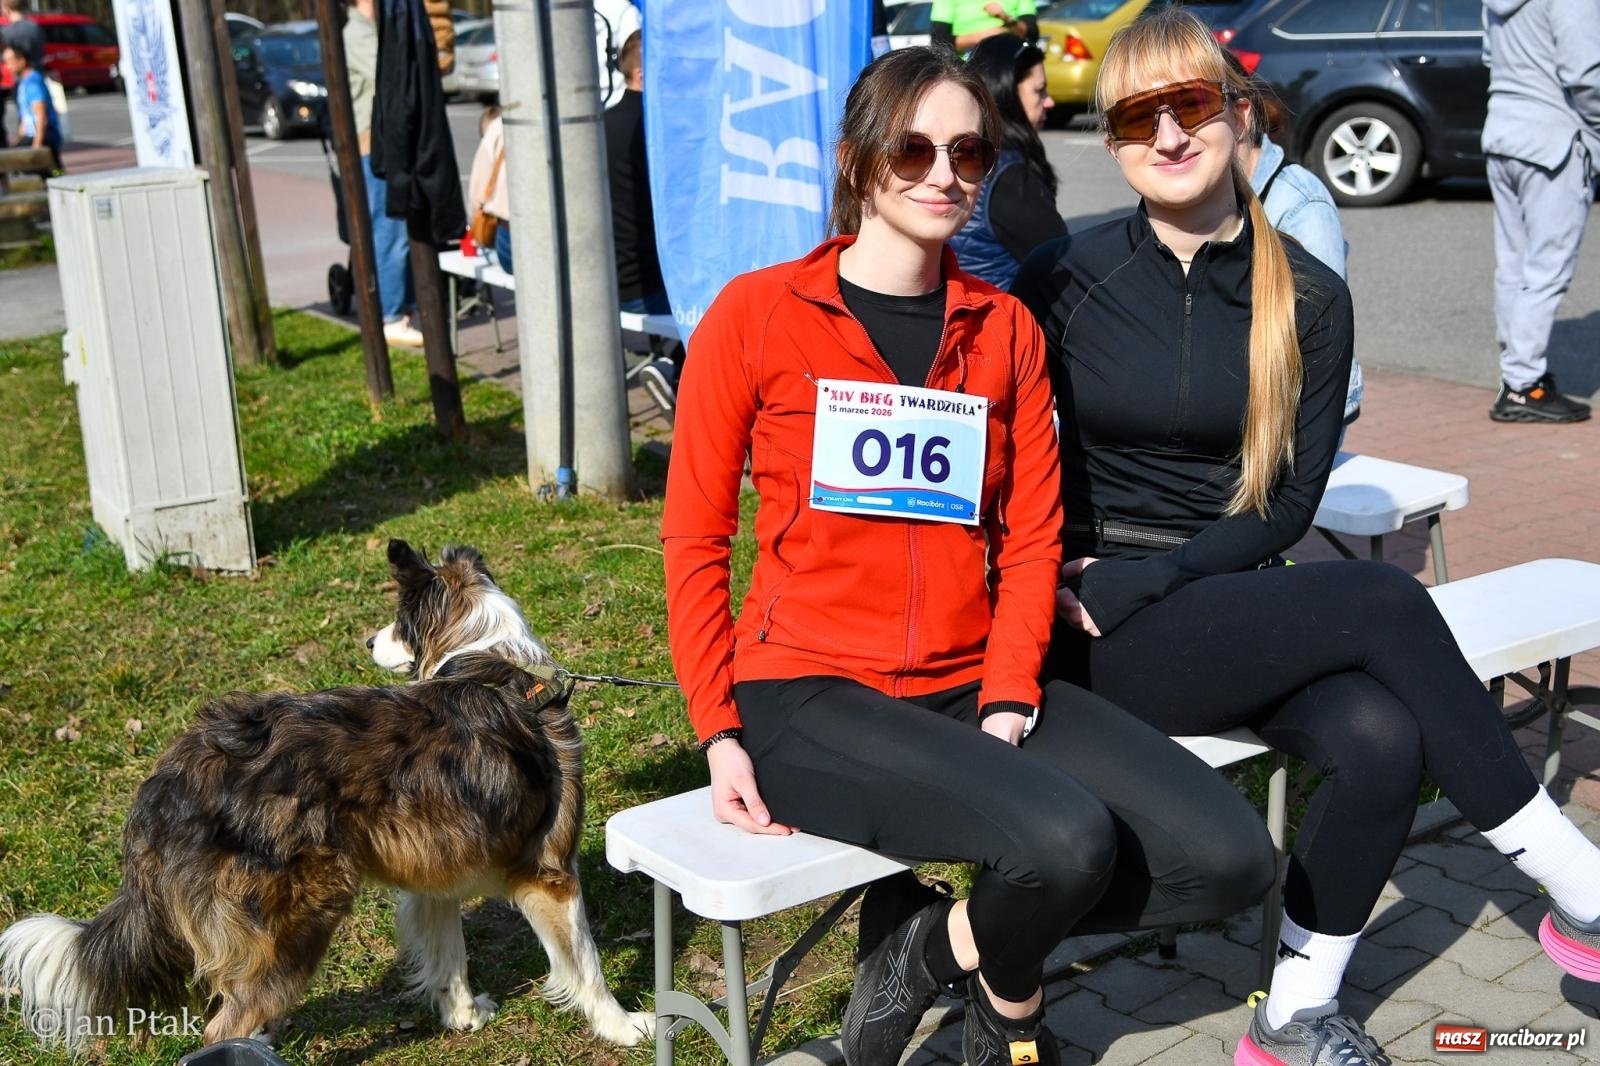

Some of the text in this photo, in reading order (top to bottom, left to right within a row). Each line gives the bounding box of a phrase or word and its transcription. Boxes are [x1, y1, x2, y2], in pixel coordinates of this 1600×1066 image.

[830, 390, 855, 402] XIV
[860, 392, 893, 406] BIEG
[839, 406, 869, 415] marzec
[871, 408, 893, 417] 2026
[852, 428, 951, 484] 016
